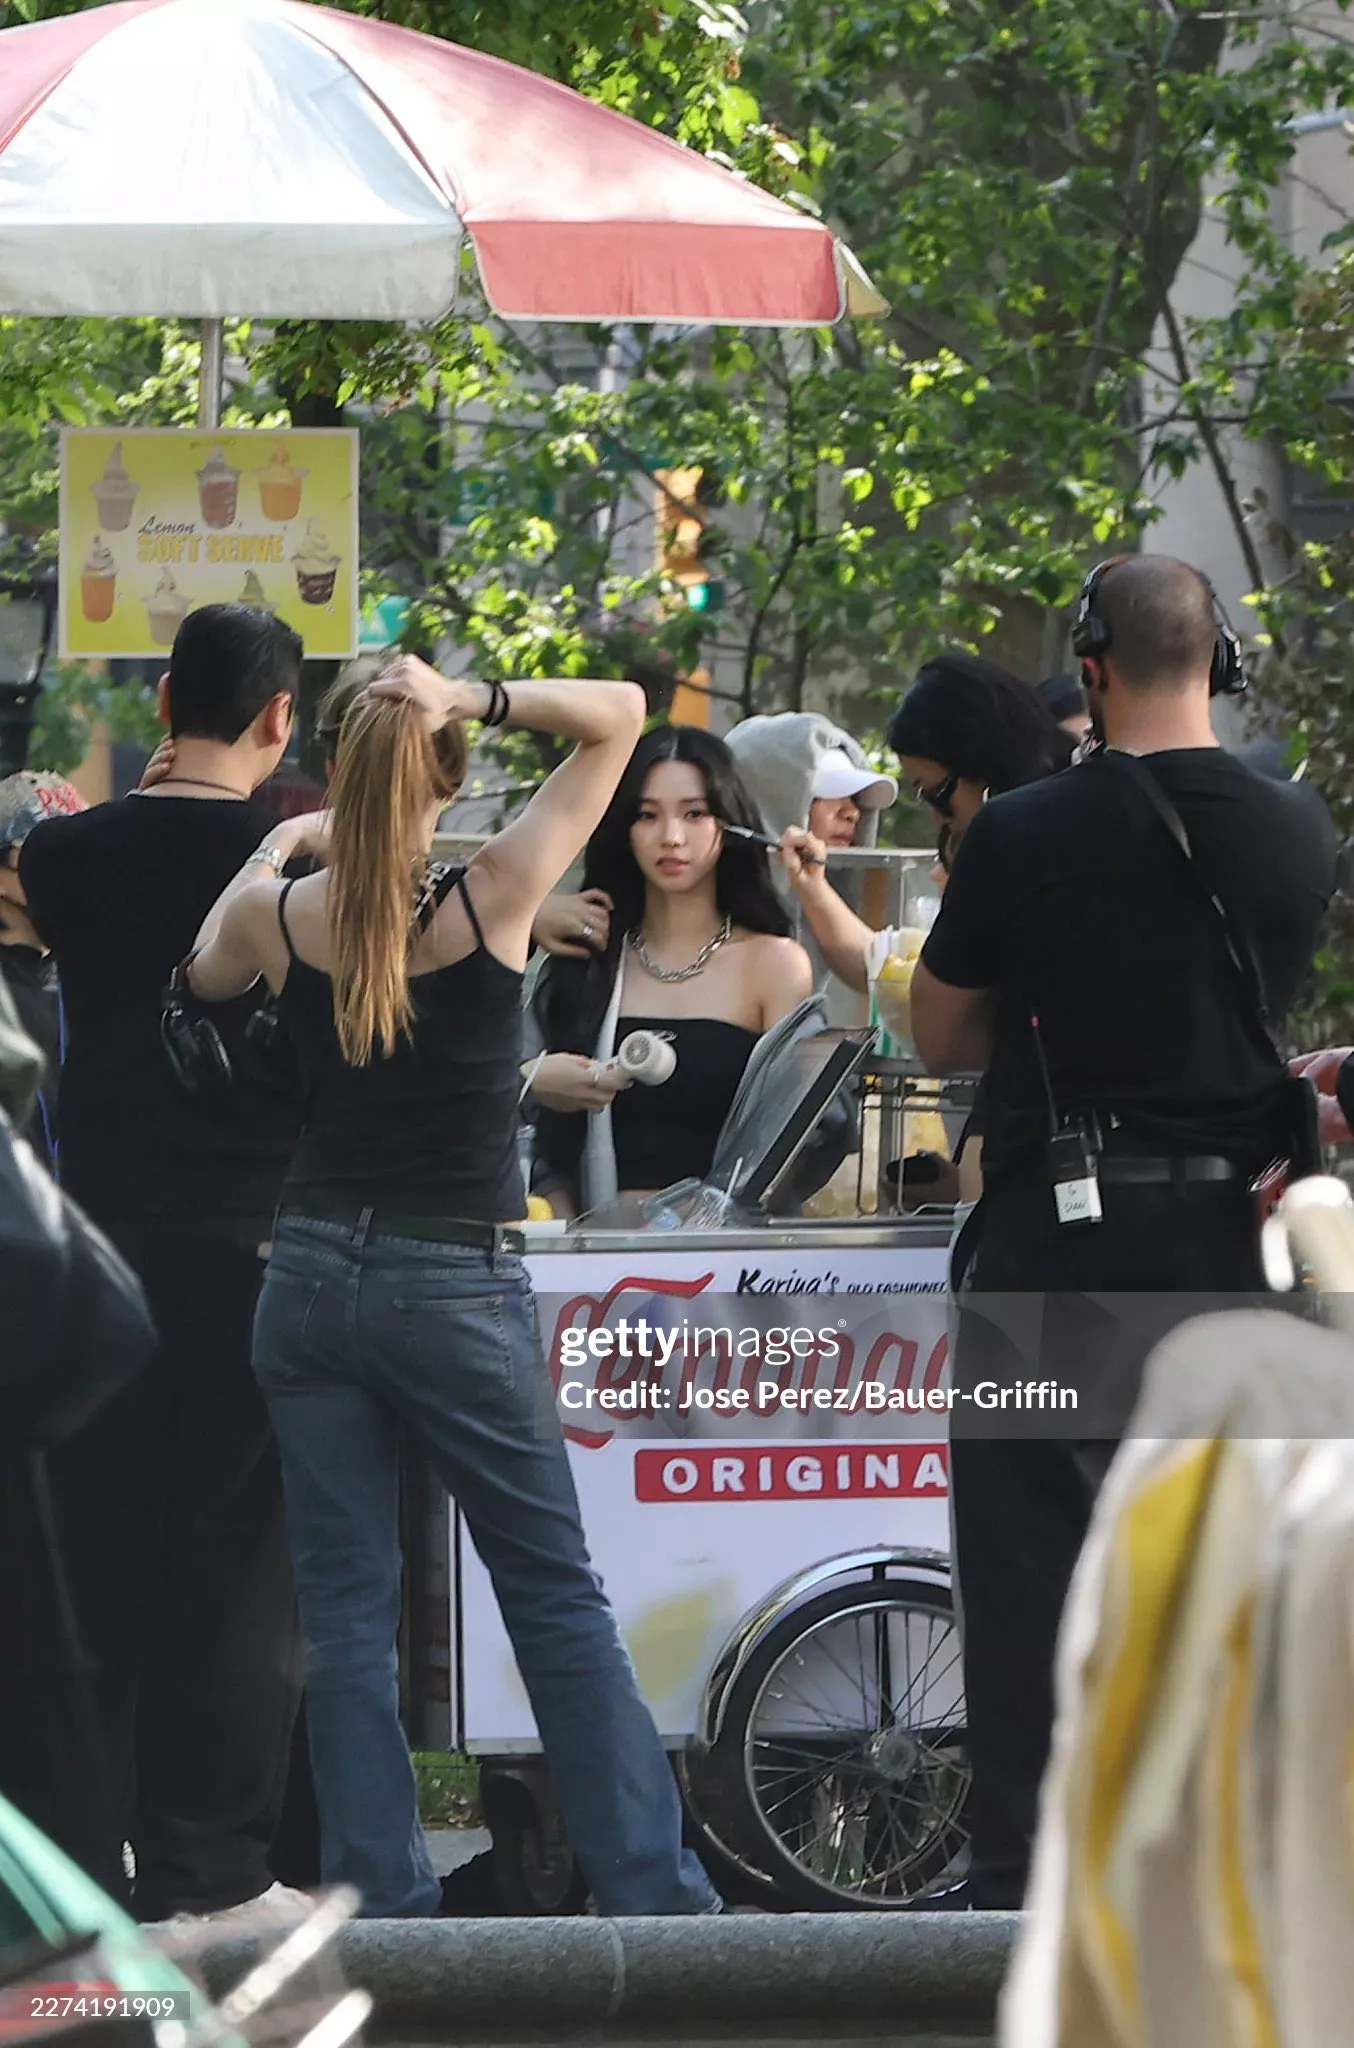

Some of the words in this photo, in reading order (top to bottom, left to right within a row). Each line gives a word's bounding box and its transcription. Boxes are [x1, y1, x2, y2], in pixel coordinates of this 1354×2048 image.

[138, 515, 196, 535] Lemon
[137, 534, 200, 563] SOFT
[205, 533, 284, 563] SERVE
[736, 1268, 840, 1297] Karina's
[846, 1280, 873, 1296] OLD
